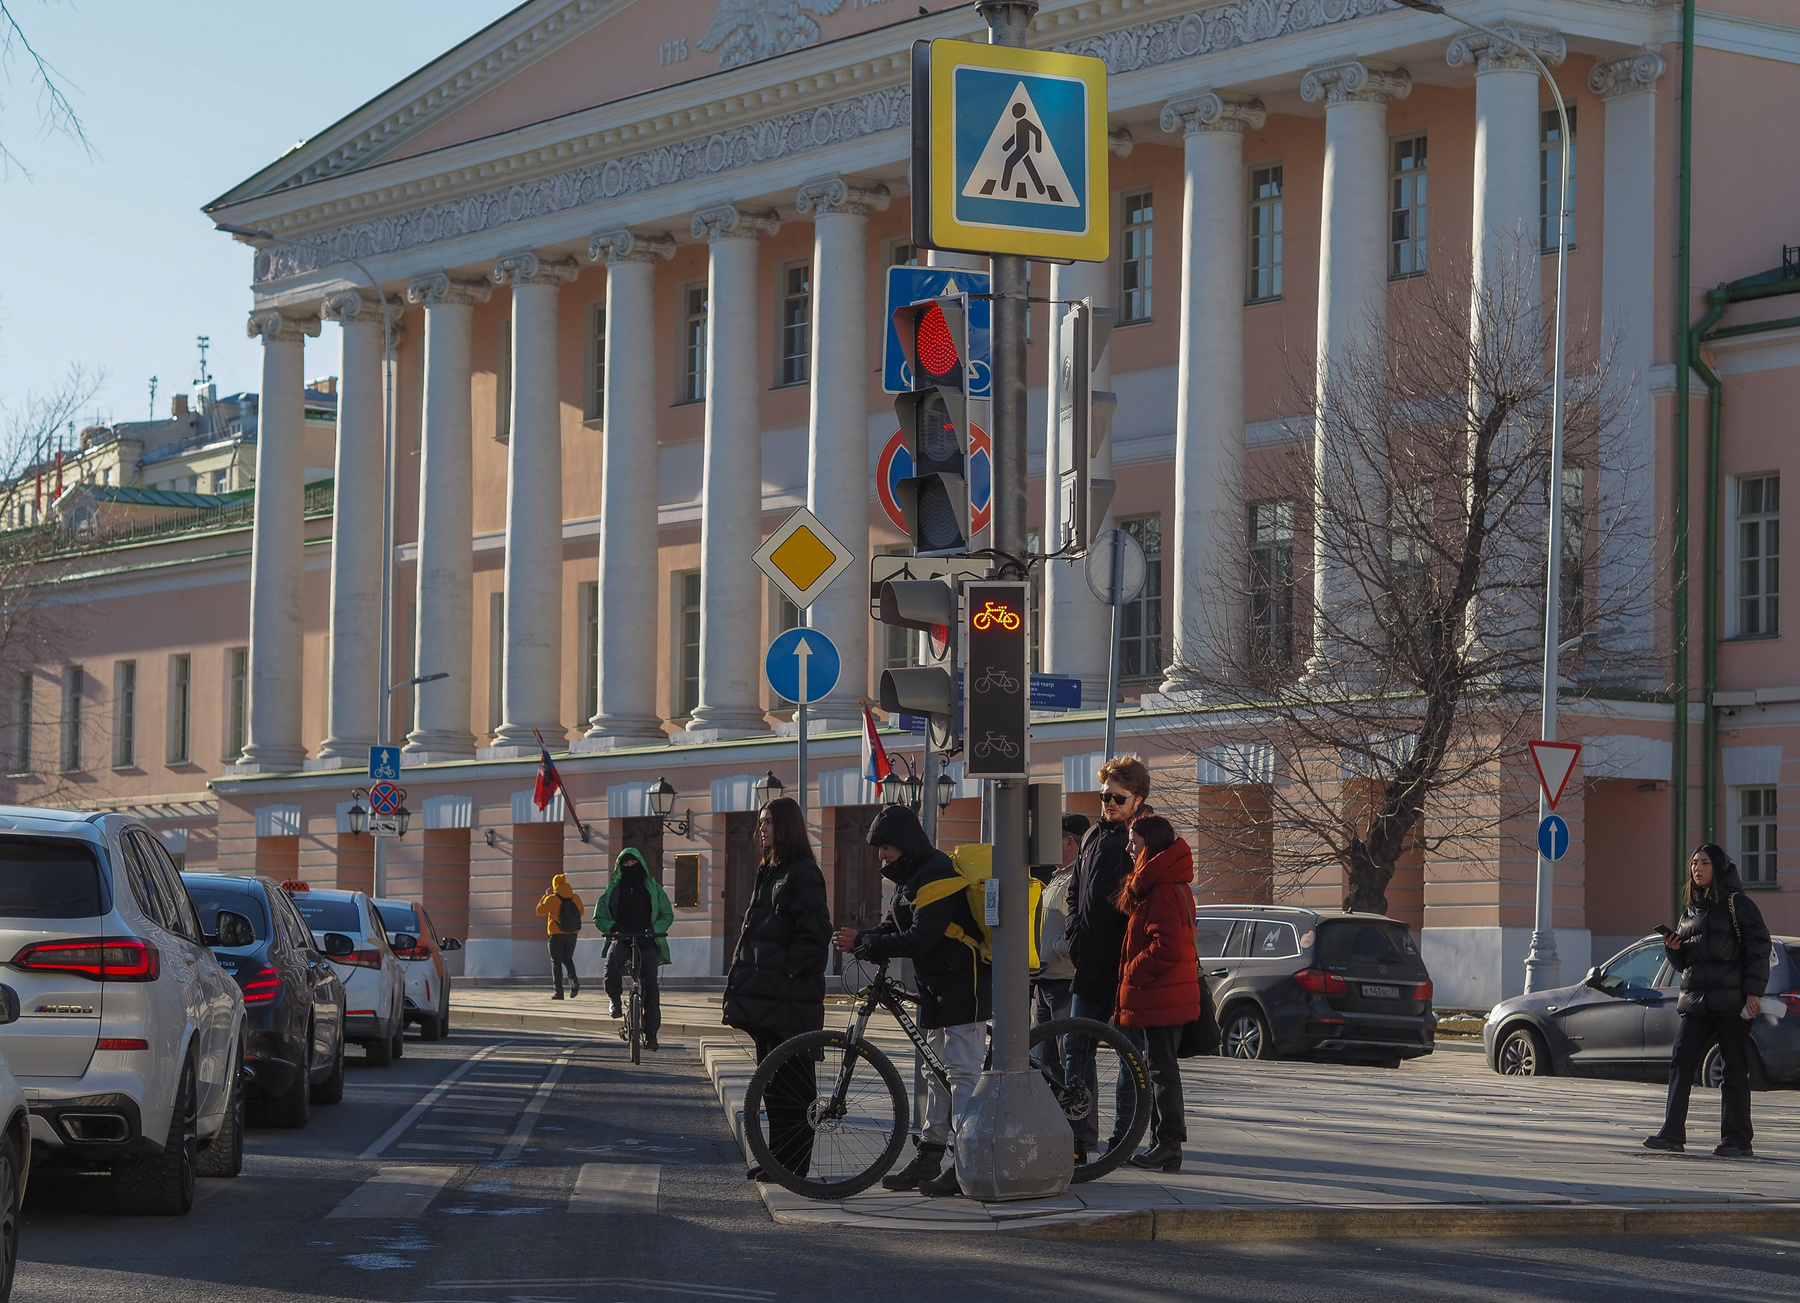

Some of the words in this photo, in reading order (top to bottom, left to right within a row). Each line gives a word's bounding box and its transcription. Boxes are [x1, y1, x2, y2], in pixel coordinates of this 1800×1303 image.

[658, 38, 688, 66] 1775
[45, 1005, 93, 1014] M50d
[898, 1013, 946, 1072] OUTLEAP
[1126, 1052, 1146, 1089] MAXXIS
